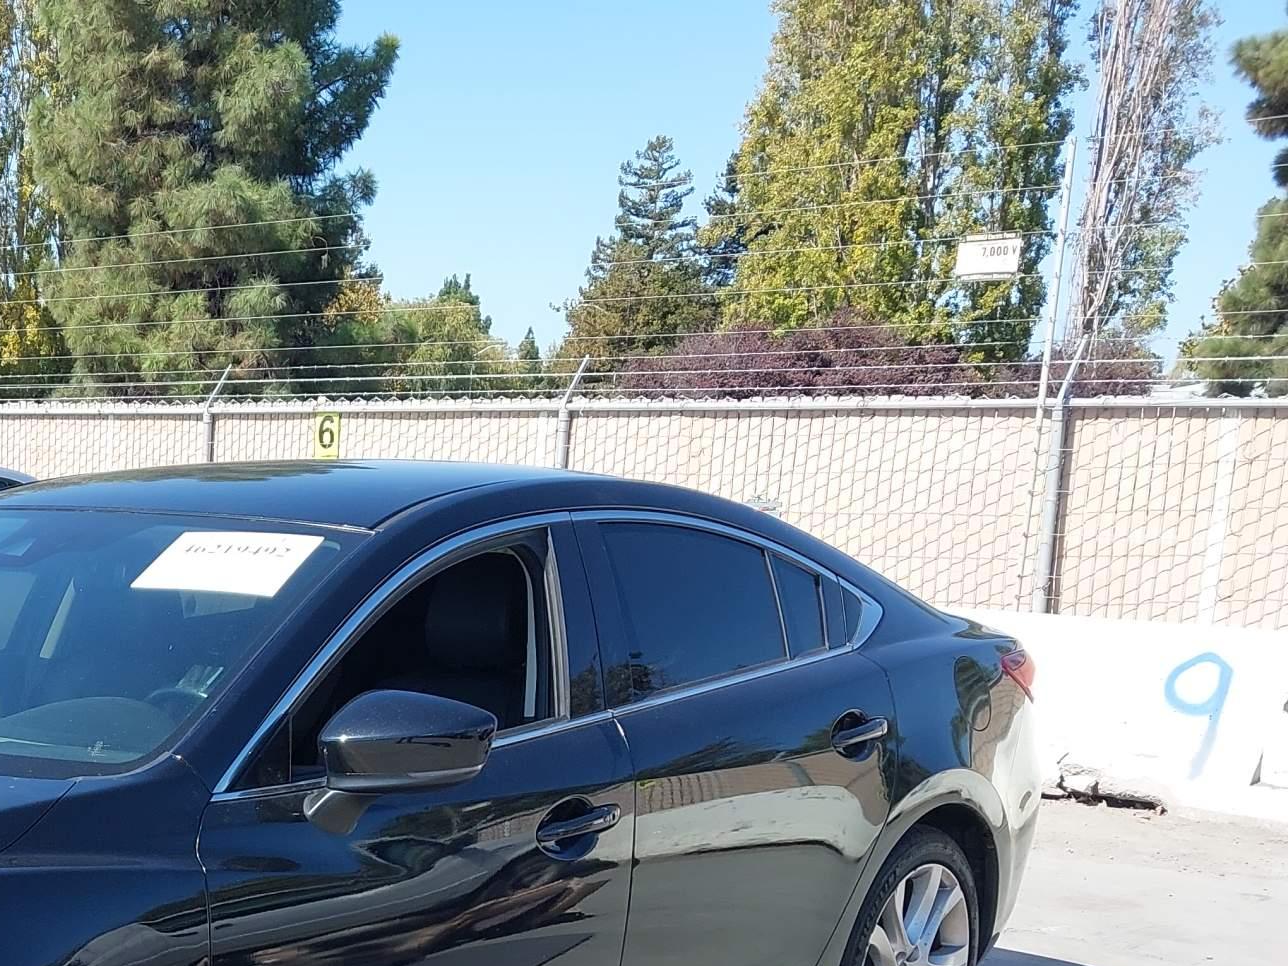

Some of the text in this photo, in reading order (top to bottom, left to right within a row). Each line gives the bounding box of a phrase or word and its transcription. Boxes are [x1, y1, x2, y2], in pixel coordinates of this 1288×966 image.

[981, 245, 1009, 258] 7,000
[318, 414, 335, 449] 6
[1164, 651, 1233, 781] 9
